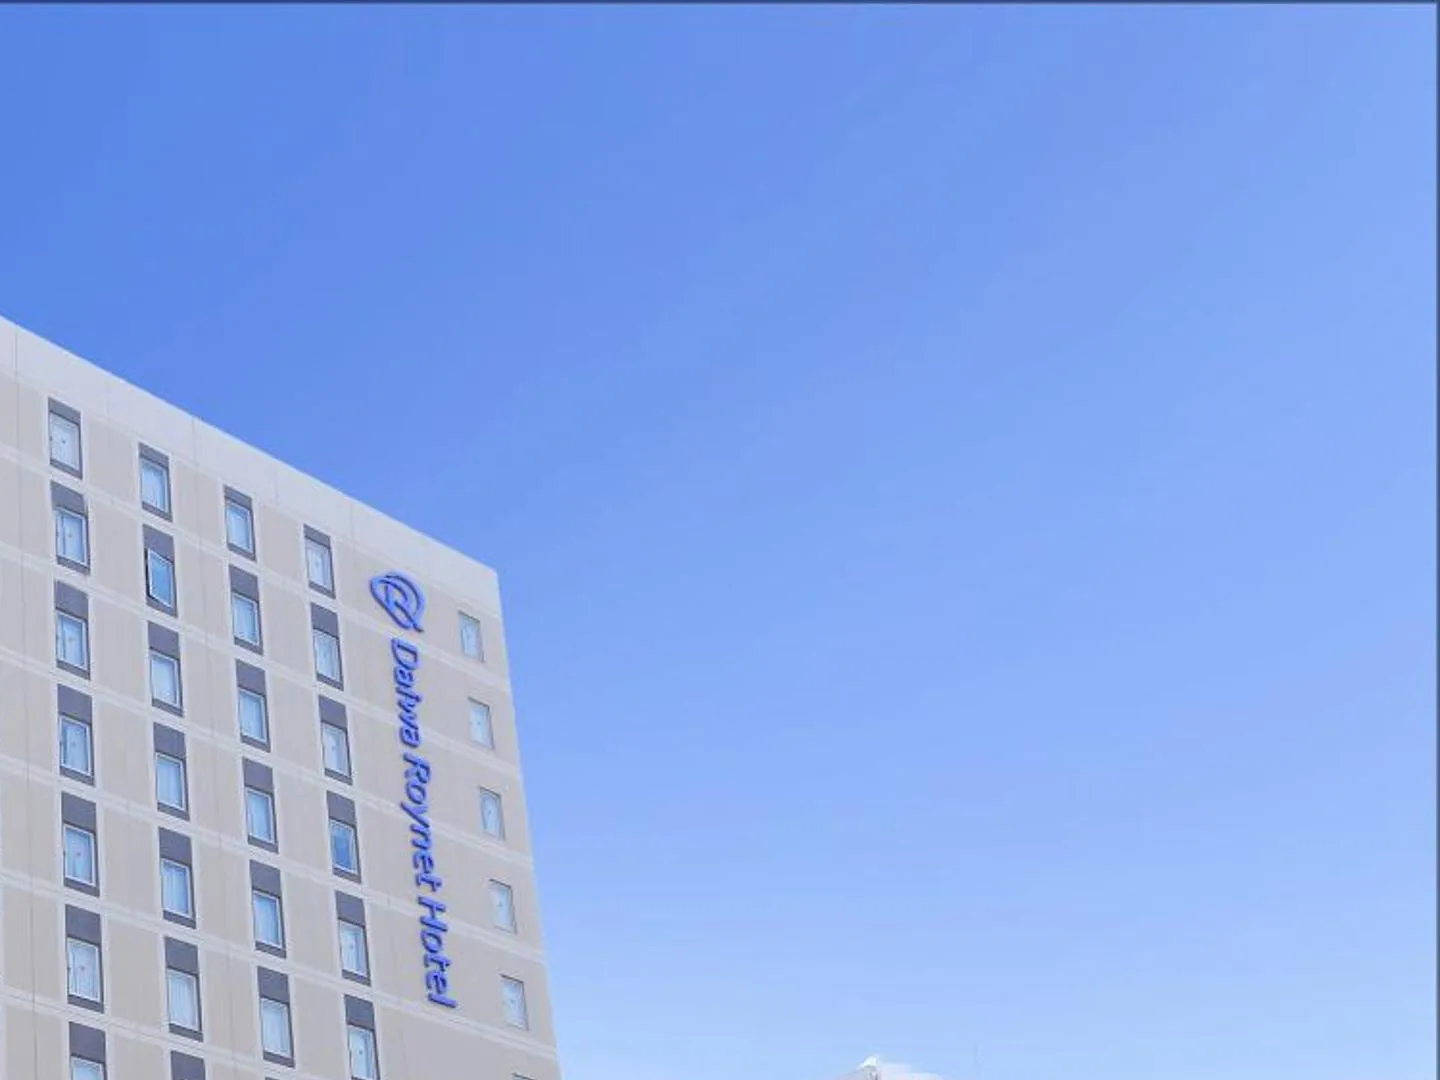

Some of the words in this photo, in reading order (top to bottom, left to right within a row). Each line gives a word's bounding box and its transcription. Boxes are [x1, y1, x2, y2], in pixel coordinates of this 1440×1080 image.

[391, 638, 424, 747] Daiwa
[400, 750, 443, 892] Roynet
[416, 894, 457, 1009] Hotel
